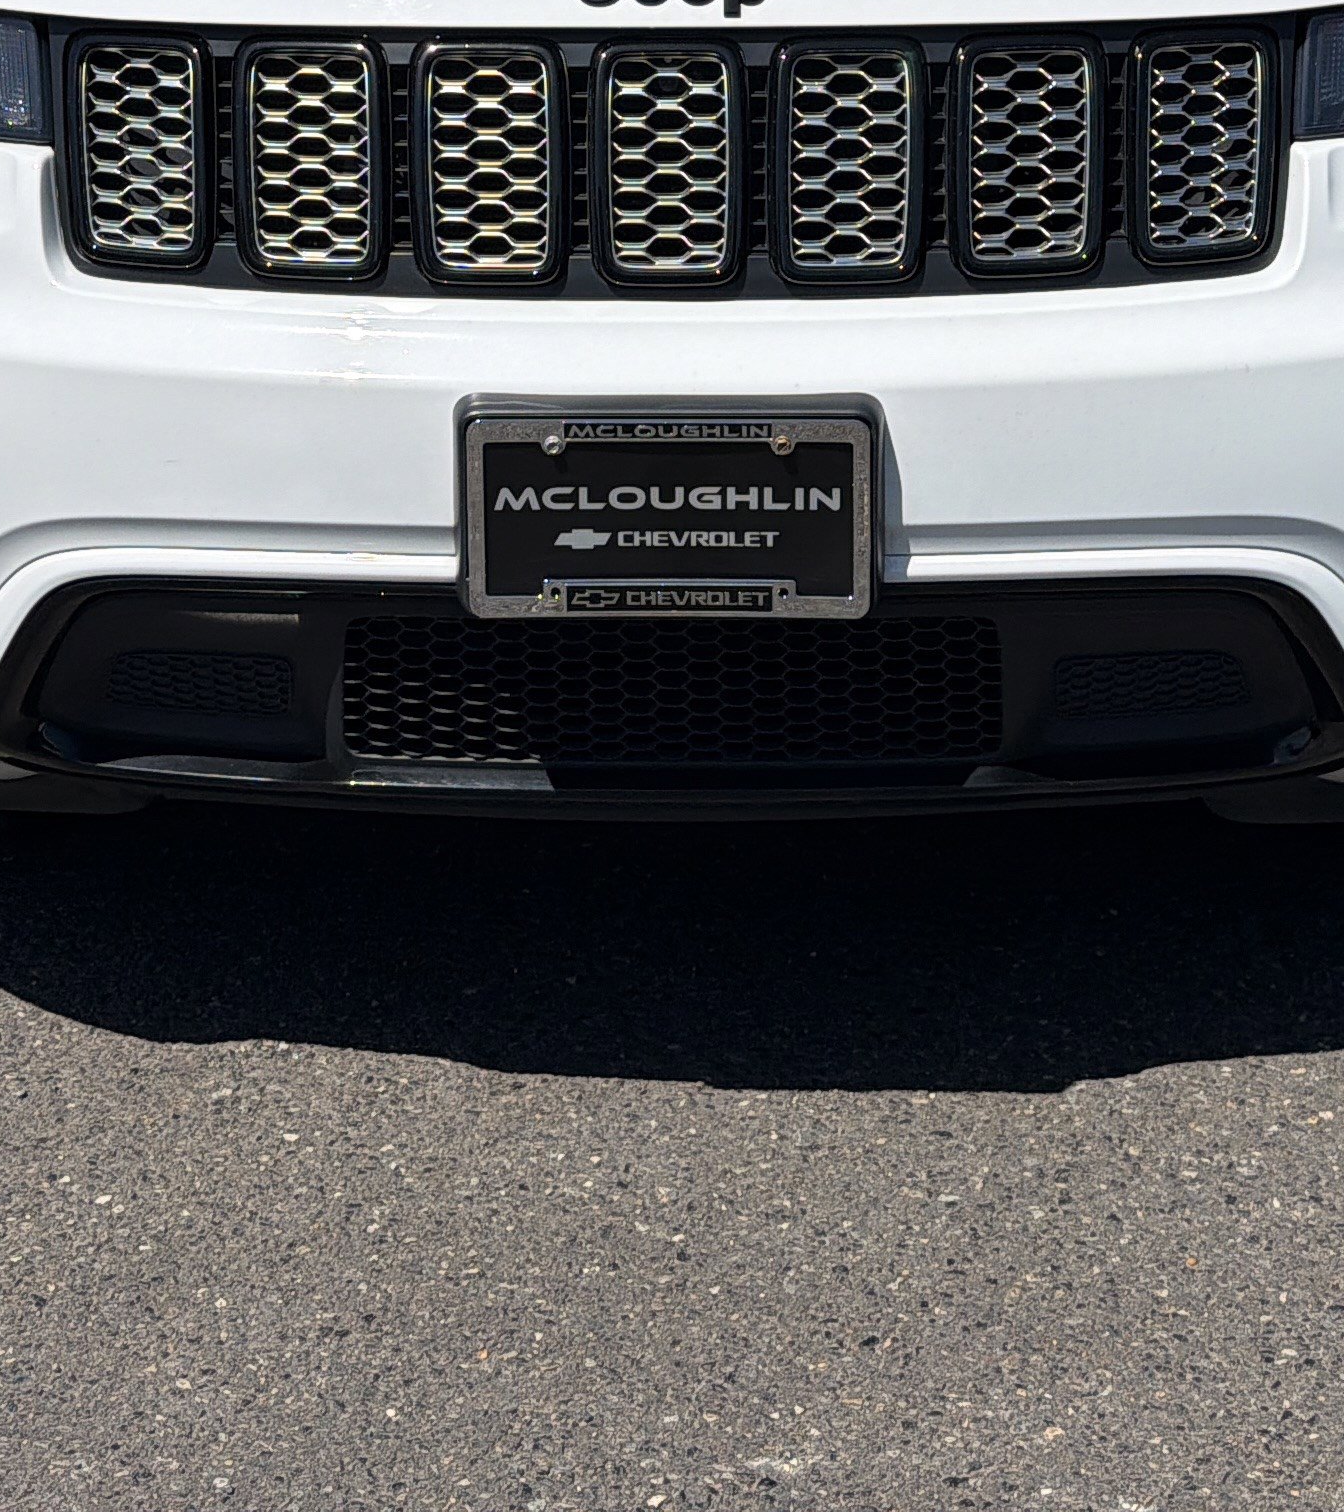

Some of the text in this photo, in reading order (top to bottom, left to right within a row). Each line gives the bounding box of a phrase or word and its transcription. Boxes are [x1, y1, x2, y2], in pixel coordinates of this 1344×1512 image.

[568, 423, 772, 439] MCLOUGHLIN
[493, 485, 842, 511] MCLOUGHLIN
[617, 530, 780, 548] CHEVROLET
[625, 589, 770, 607] CHEVROLET
